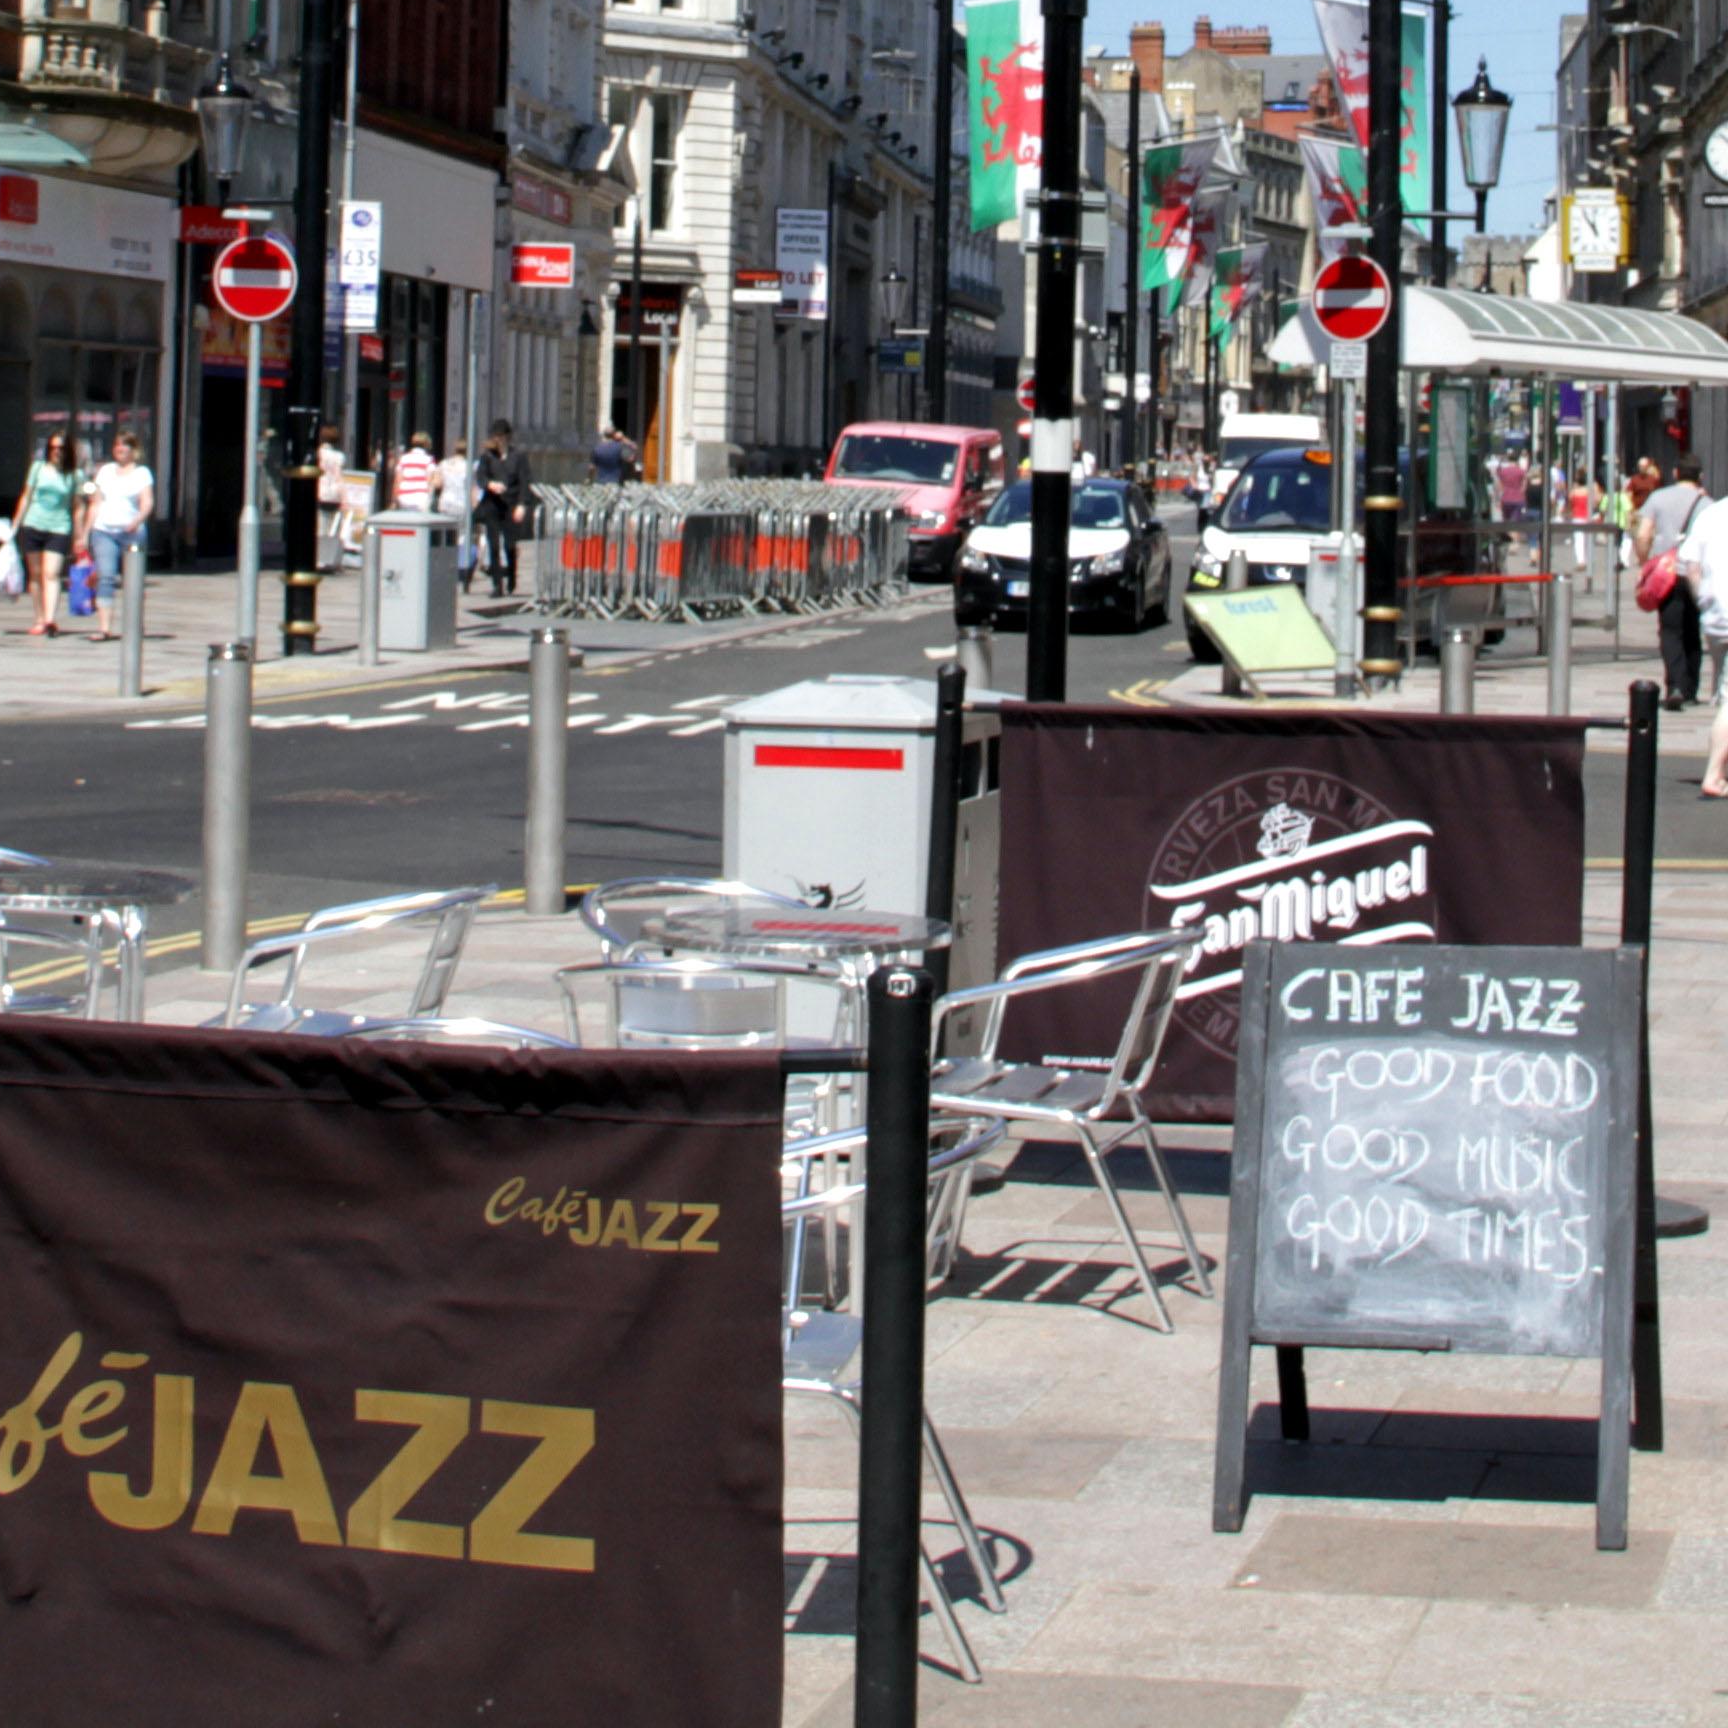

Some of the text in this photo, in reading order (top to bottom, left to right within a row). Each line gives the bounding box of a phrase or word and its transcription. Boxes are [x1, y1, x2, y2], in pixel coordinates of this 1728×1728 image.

[1235, 843, 1428, 942] Miguel
[1281, 966, 1425, 1026] CAFE
[1451, 972, 1586, 1035] JAZZ
[1309, 1046, 1599, 1120] GOOD FOOD
[1281, 1115, 1588, 1199] GOOD MUSIC
[568, 1197, 721, 1255] JAZZ
[1285, 1192, 1432, 1271] GOOD
[86, 1373, 597, 1573] JAZZ
